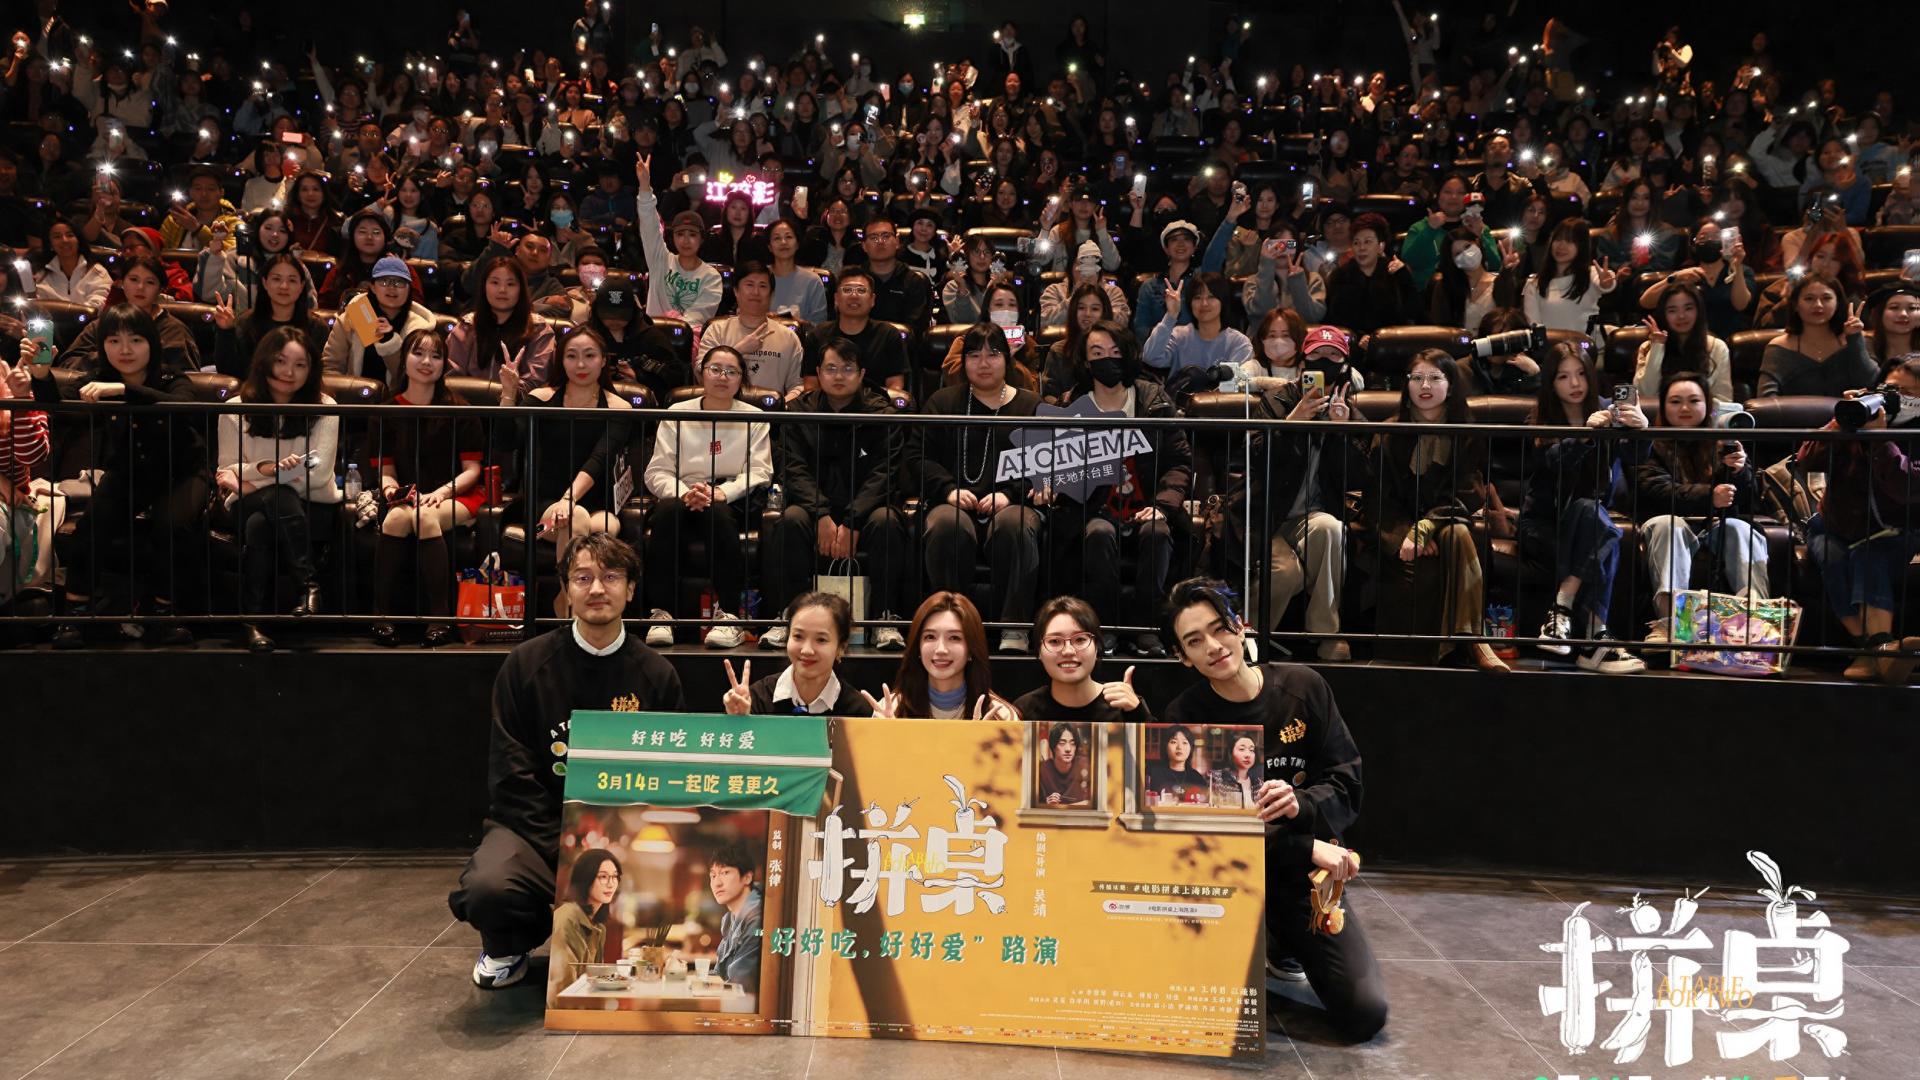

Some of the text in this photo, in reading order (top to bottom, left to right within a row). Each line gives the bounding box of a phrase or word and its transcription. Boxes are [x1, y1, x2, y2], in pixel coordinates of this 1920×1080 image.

[78, 314, 85, 322] 6
[220, 389, 227, 397] 7
[362, 388, 369, 396] 8
[632, 396, 642, 405] 10
[765, 397, 774, 405] 11
[896, 399, 905, 407] 12
[1035, 430, 1147, 468] CINEMA
[550, 729, 559, 739] A
[631, 728, 755, 750] 好好吃 好好爱
[1266, 757, 1287, 769] FOR
[597, 772, 780, 796] 3月14日 一起吃 爱更久
[807, 774, 1009, 917] 拼桌
[1133, 884, 1229, 897] #电影拼桌上海路演#
[1001, 935, 1059, 966] 路演
